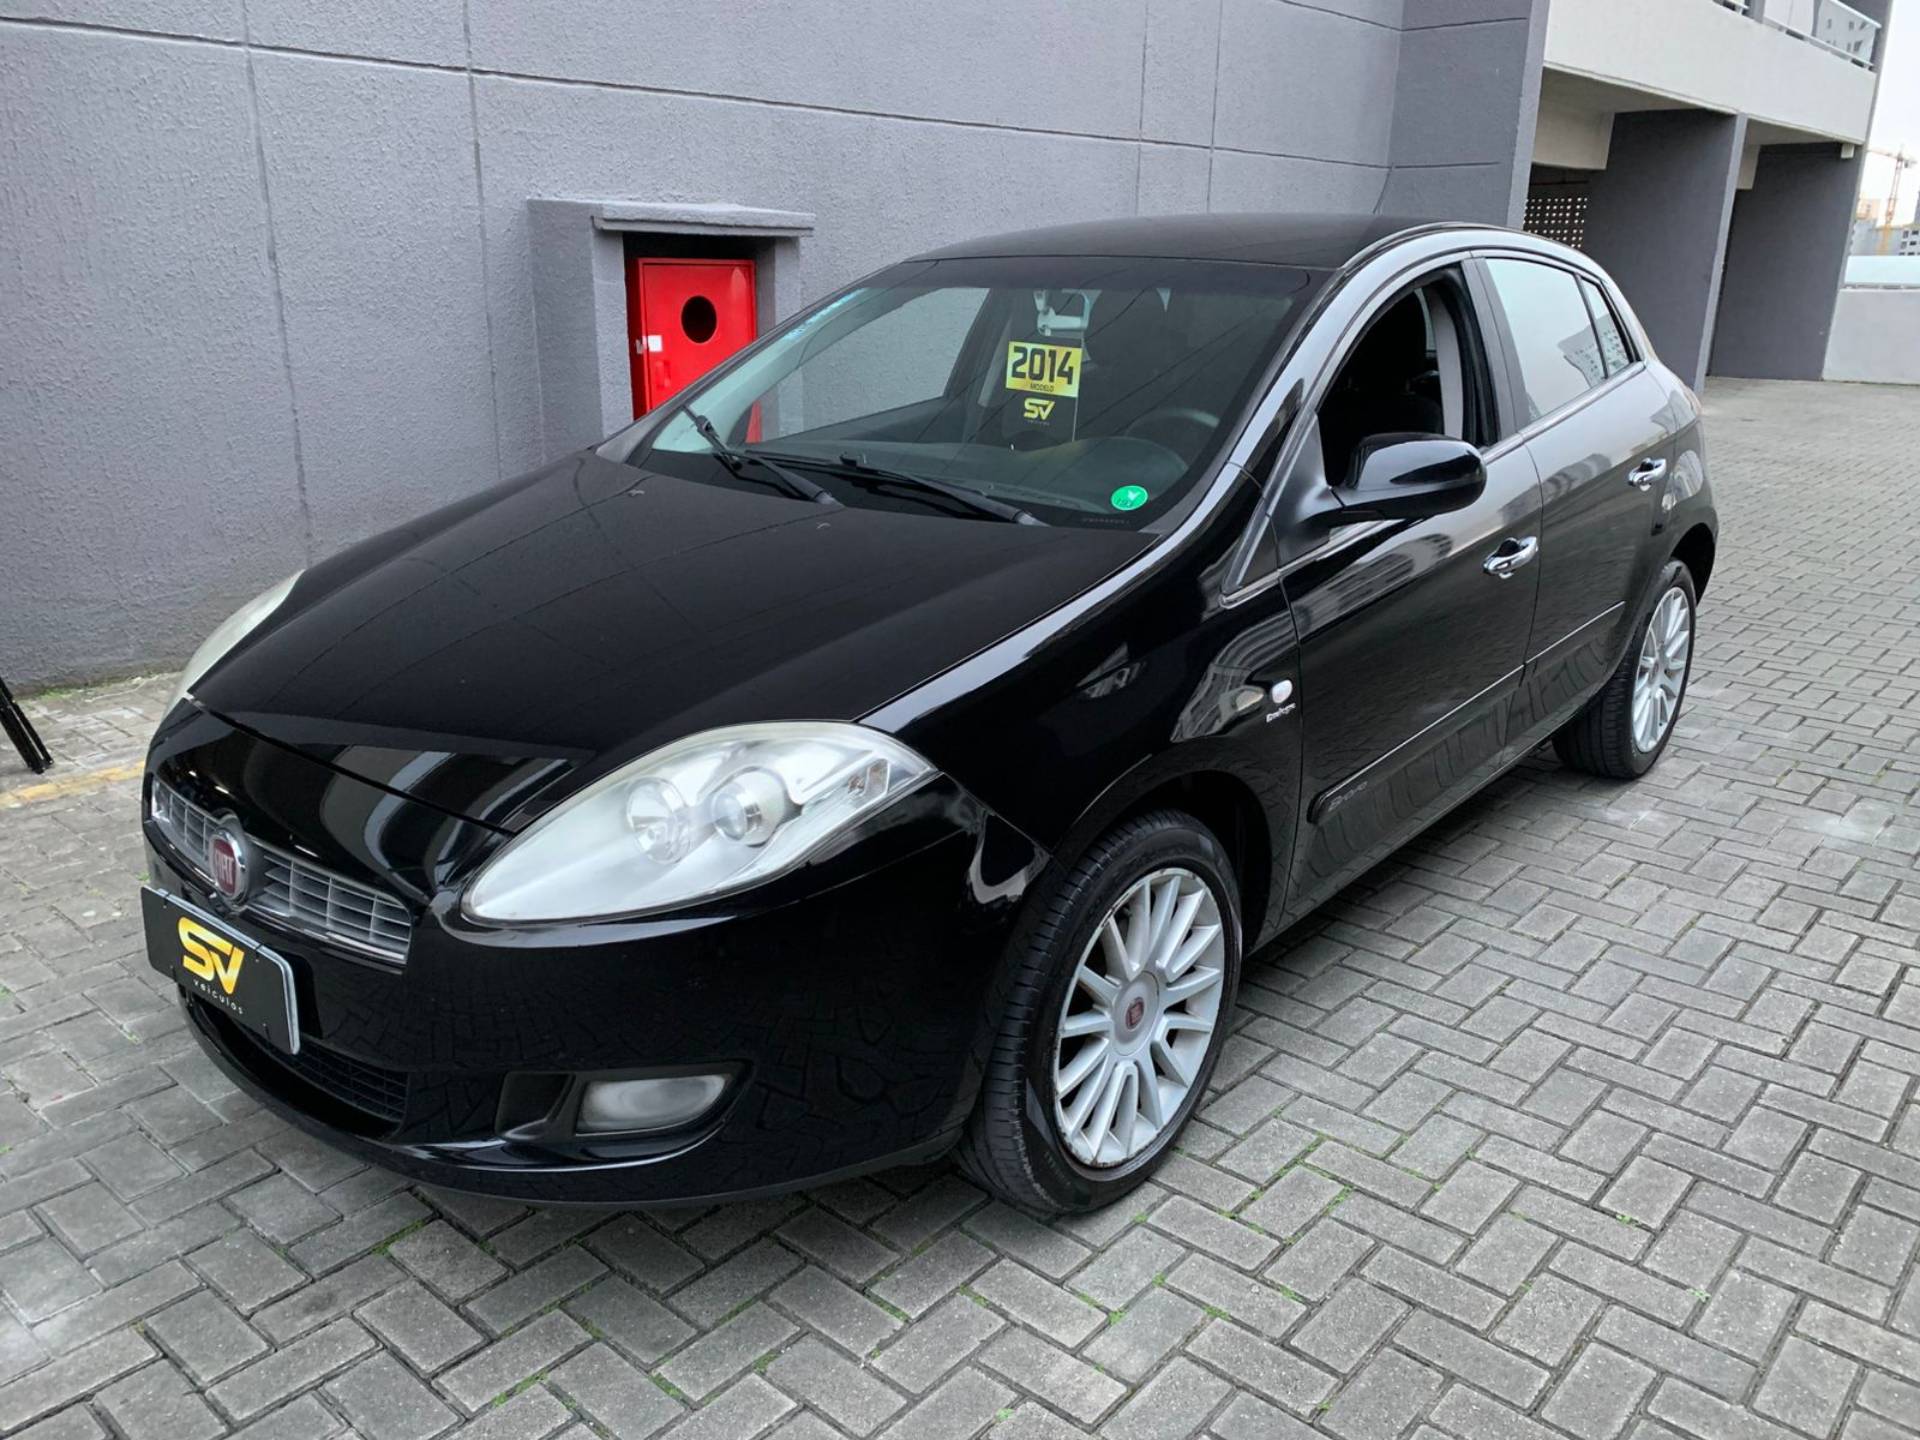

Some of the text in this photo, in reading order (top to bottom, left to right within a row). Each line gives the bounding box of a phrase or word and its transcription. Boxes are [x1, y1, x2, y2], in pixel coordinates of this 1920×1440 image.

[1011, 345, 1075, 386] 2014
[1023, 397, 1056, 421] SV
[178, 916, 245, 995] SV
